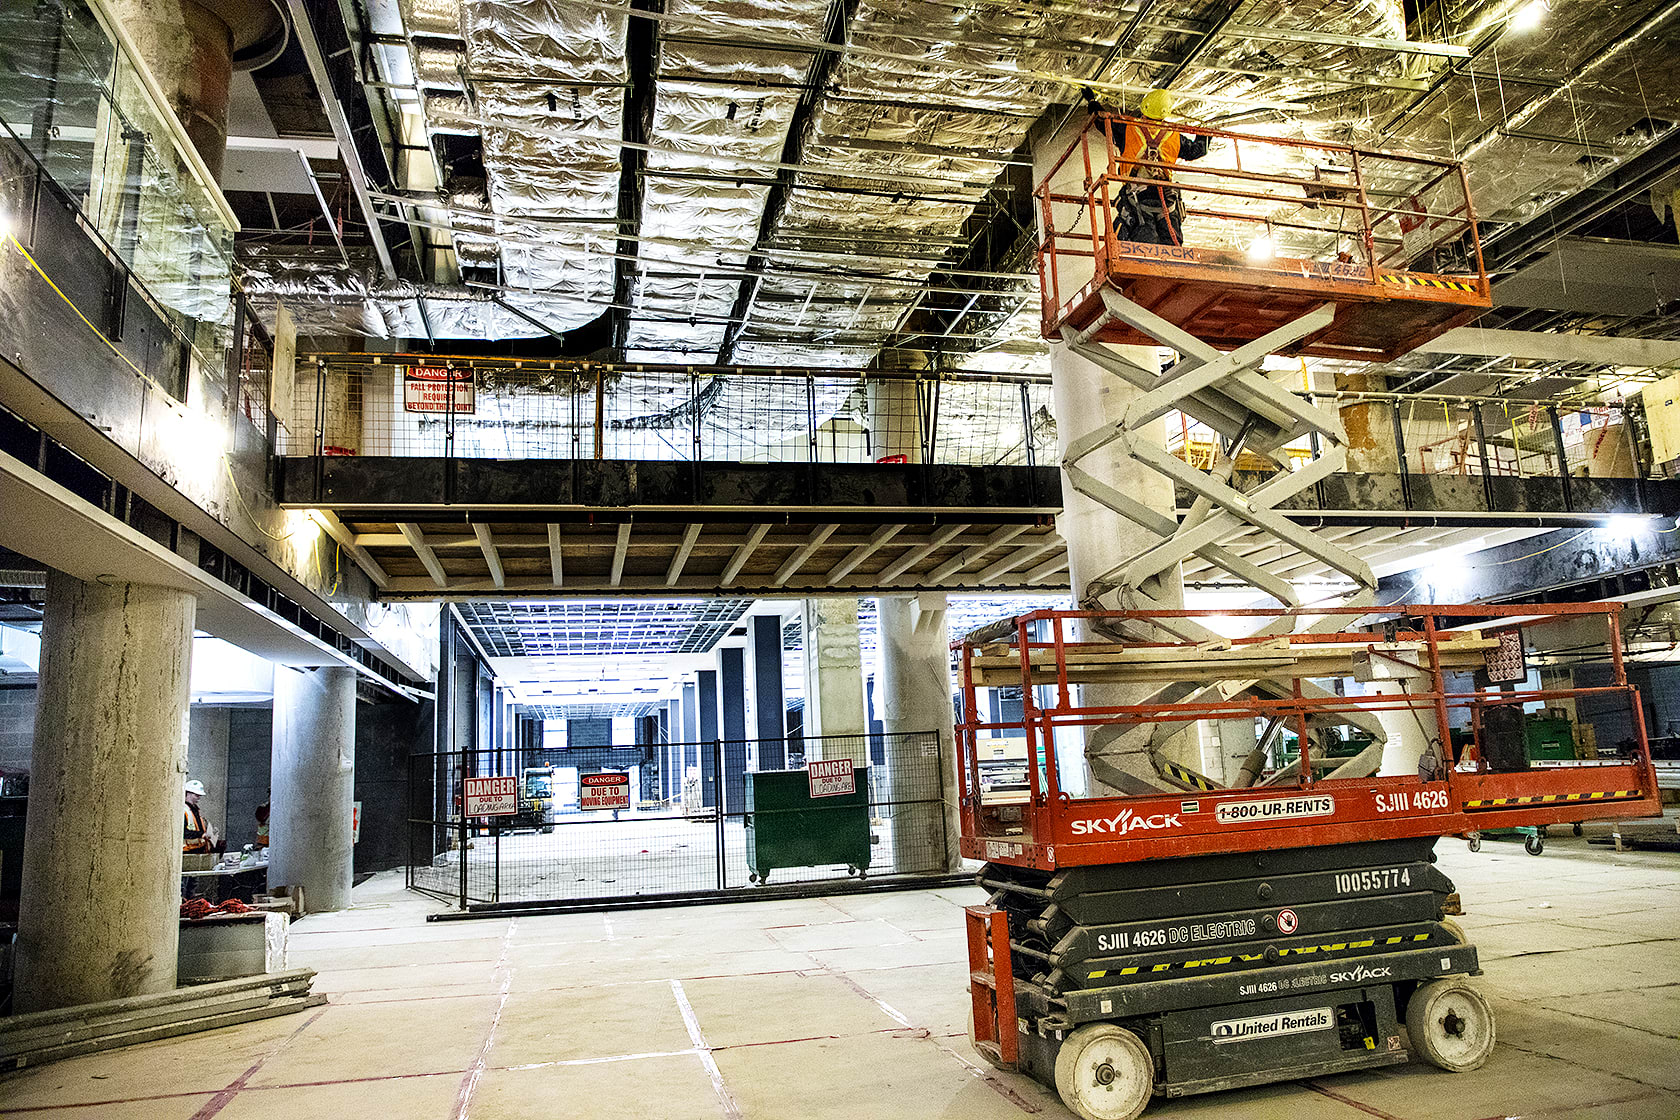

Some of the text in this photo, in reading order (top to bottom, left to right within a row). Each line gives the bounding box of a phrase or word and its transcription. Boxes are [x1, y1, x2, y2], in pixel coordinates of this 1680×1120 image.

[1120, 242, 1194, 259] SKYJACK
[410, 383, 426, 391] FALL
[408, 402, 434, 410] BEYOND
[811, 760, 851, 778] DANGER
[467, 779, 515, 796] DANGER
[590, 786, 620, 796] DUE TO
[582, 795, 629, 806] MOVING EQUIPMENT
[1220, 798, 1330, 819] 1-800-UR-RENTS
[1375, 790, 1449, 813] SJIII 4626
[1071, 808, 1182, 835] SKYJACK
[1097, 919, 1256, 951] SJIII 4626 DC ELECTRIC
[1239, 983, 1258, 996] SJIII
[1258, 981, 1278, 993] 4626
[1329, 964, 1392, 982] SKYJACK
[1235, 1012, 1328, 1036] United Rentals
